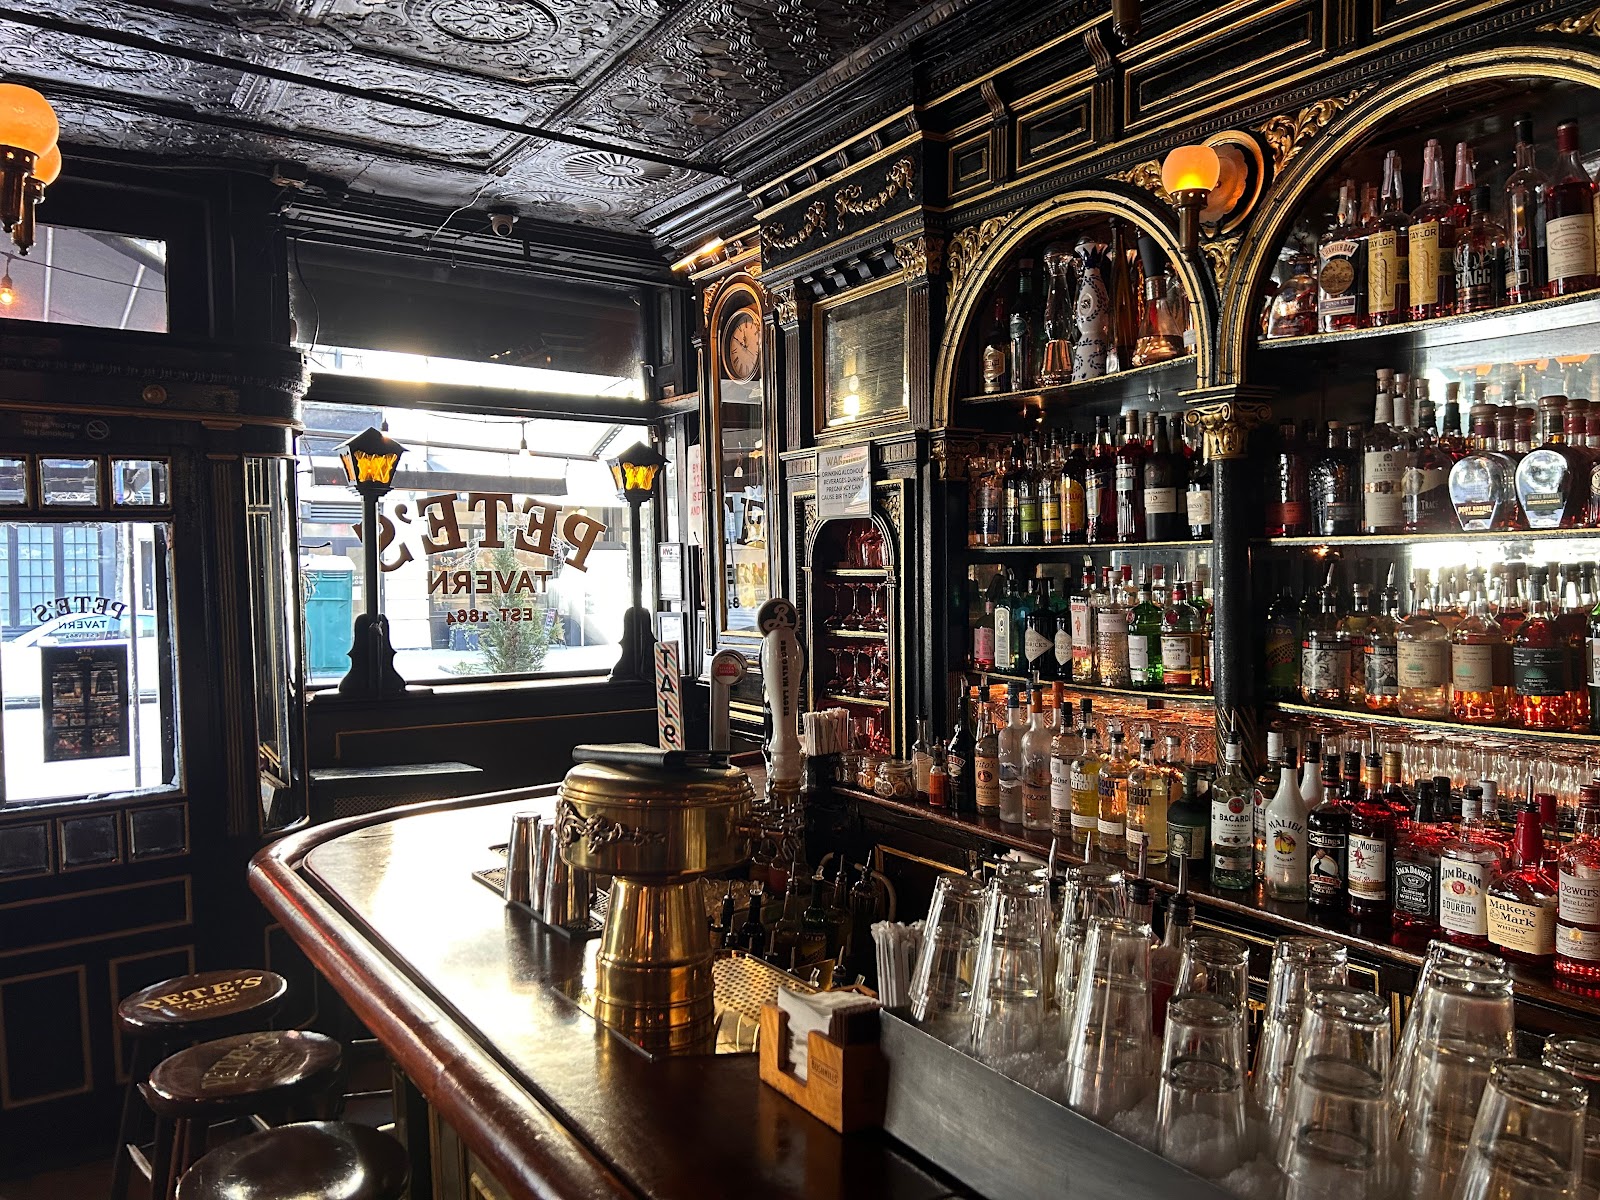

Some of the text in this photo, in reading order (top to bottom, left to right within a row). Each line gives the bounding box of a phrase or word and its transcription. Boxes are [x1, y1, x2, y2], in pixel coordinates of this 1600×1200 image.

[1369, 237, 1395, 248] TAYLOR
[1410, 229, 1437, 240] TAYLOR
[1455, 268, 1491, 289] STAGG
[24, 420, 50, 428] Thank
[51, 421, 65, 429] You
[39, 430, 75, 439] Smoking
[780, 640, 789, 687] BROOKLYN
[975, 760, 996, 769] Tito's
[1268, 819, 1305, 835] MALIBU
[1309, 832, 1341, 847] Goslings
[1360, 840, 1385, 854] Morgan
[1273, 854, 1296, 862] ORIGINAL
[1396, 865, 1433, 882] JACK DANIEL'S
[1441, 866, 1482, 889] JIM BEAM
[1560, 881, 1599, 898] Dewar's
[1442, 899, 1477, 915] BOURBON
[1489, 899, 1536, 918] Maker's
[1500, 911, 1536, 928] Mark
[1496, 923, 1527, 935] WHISKY
[136, 976, 263, 1010] PETE'S
[173, 991, 240, 1009] TAVERN
